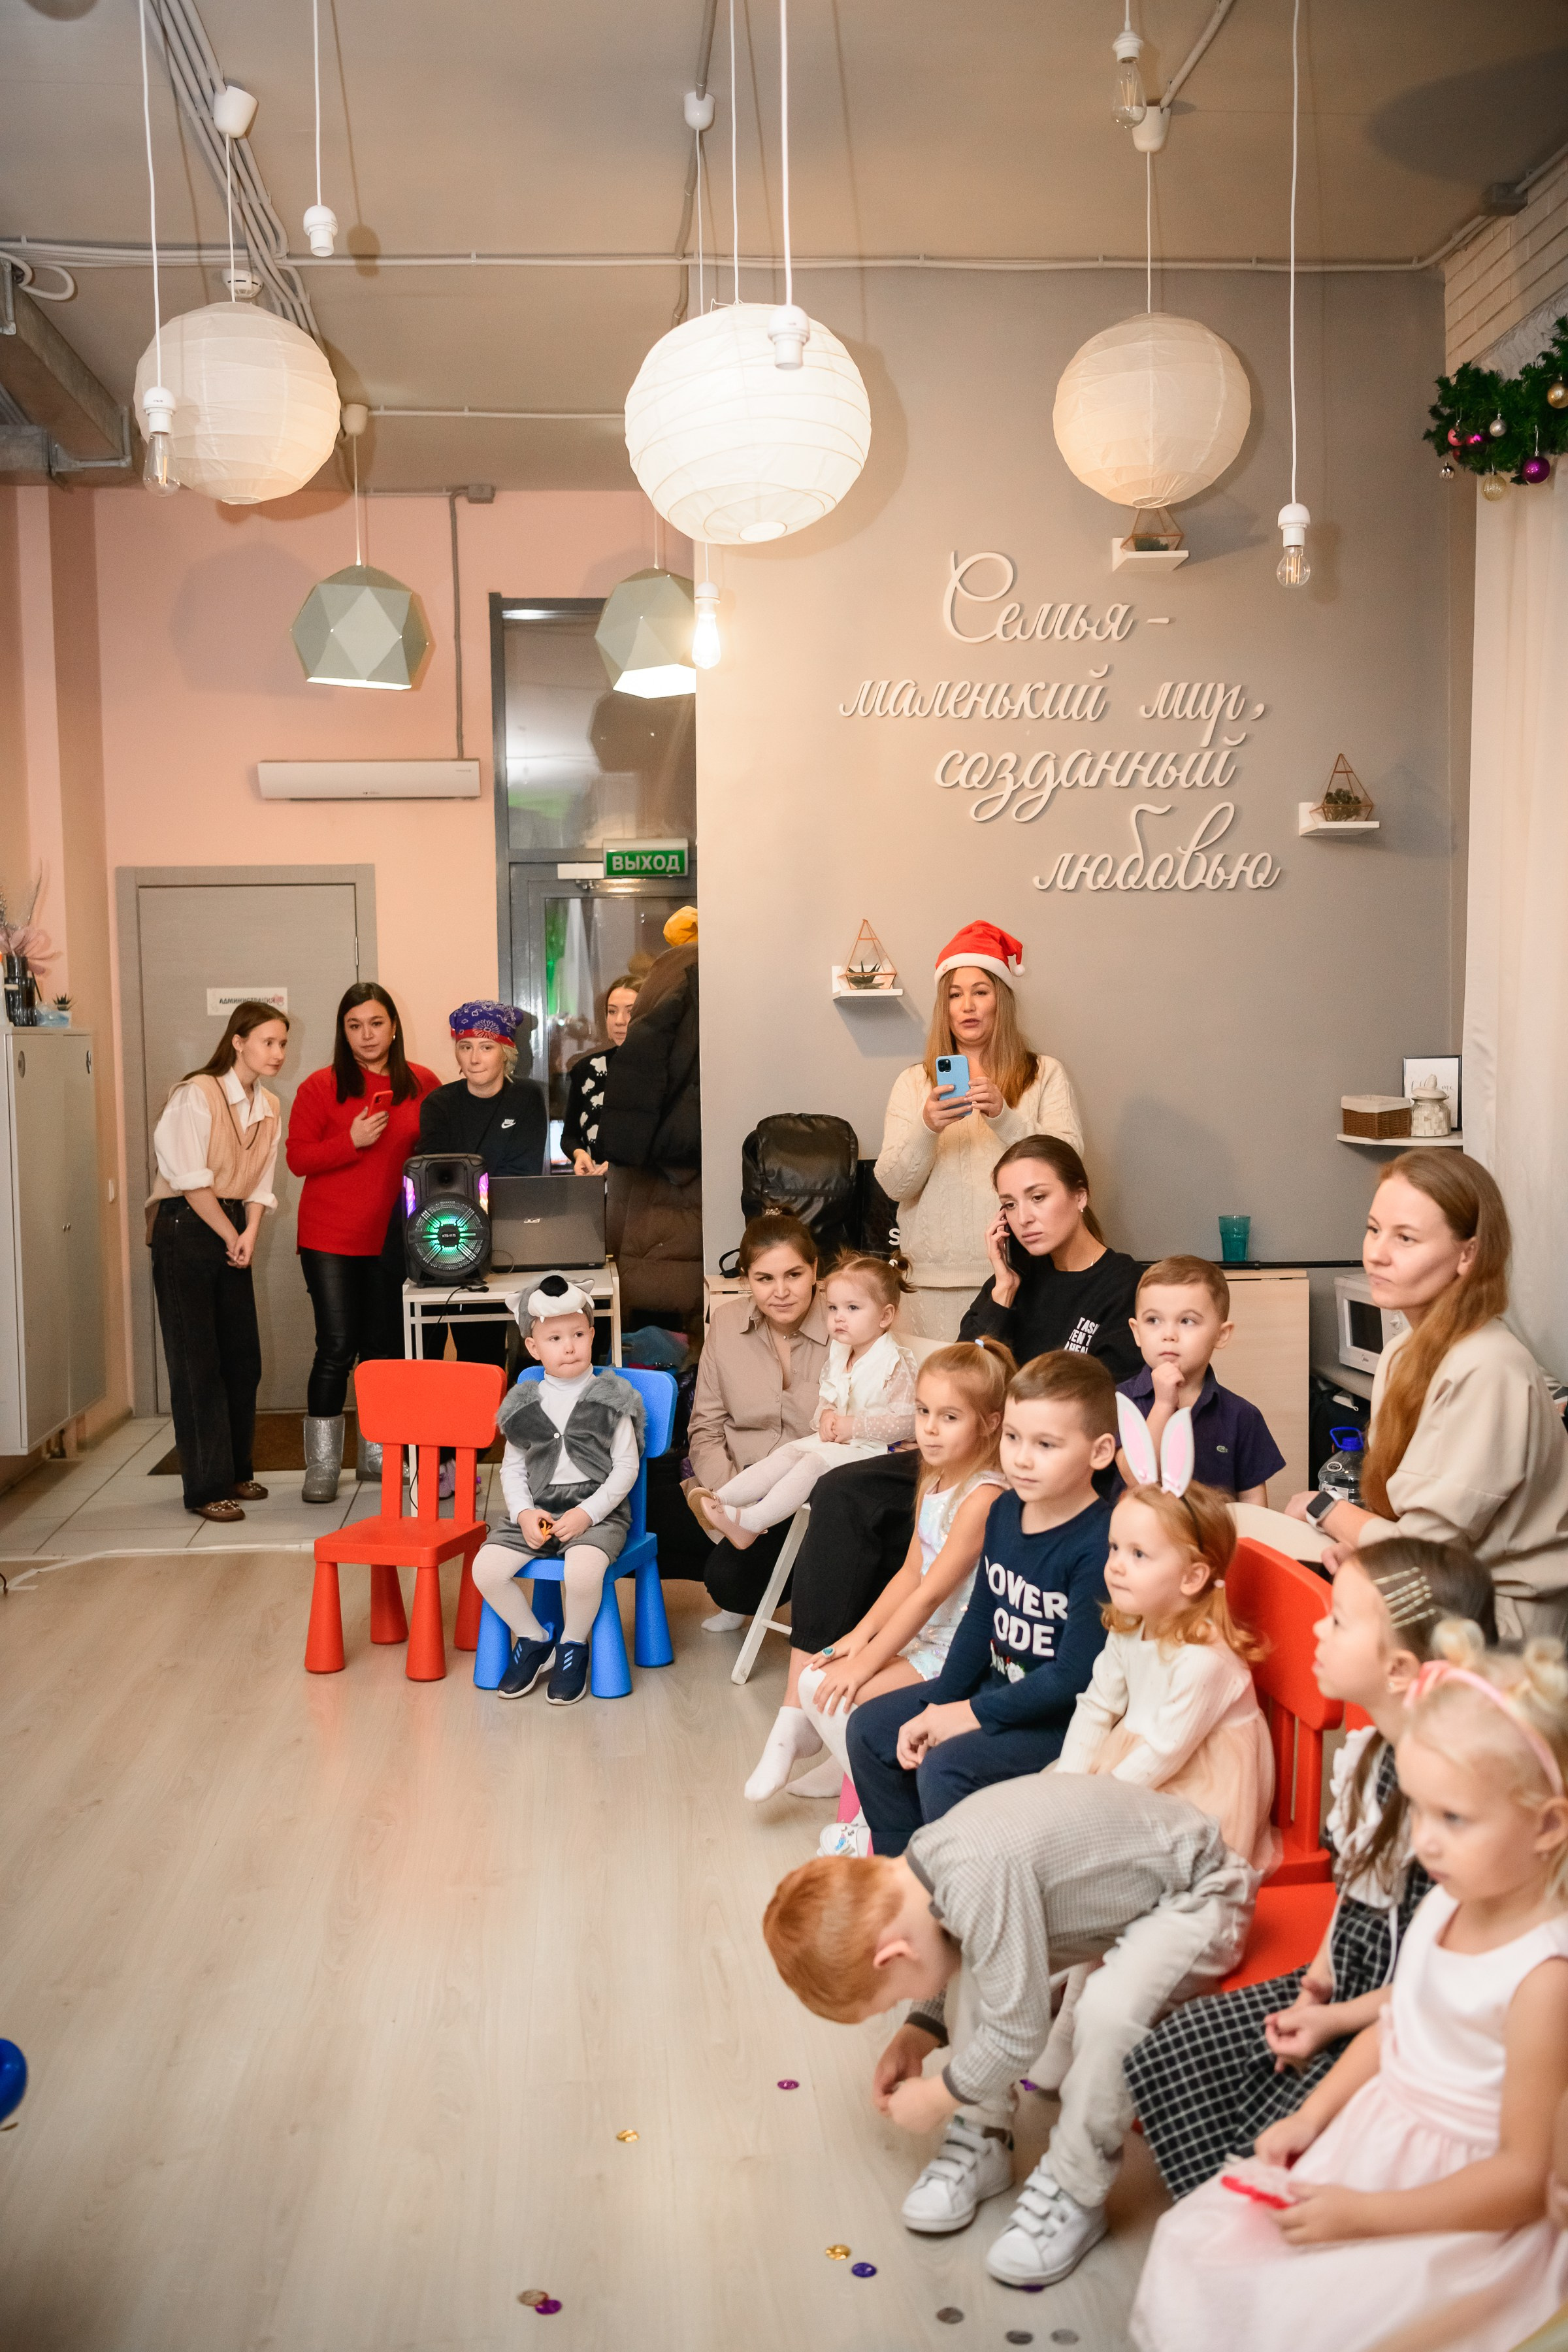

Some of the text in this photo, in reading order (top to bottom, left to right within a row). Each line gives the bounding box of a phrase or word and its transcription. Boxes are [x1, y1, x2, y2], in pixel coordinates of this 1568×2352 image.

[943, 550, 1134, 644] Семья
[838, 664, 1266, 747] маленький мир,
[934, 732, 1247, 823] созданный
[612, 855, 680, 872] ВЫХОД
[1032, 802, 1281, 890] любовью
[1069, 1329, 1086, 1345] EN
[985, 1555, 1068, 1620] OWER
[994, 1607, 1054, 1657] ODE
